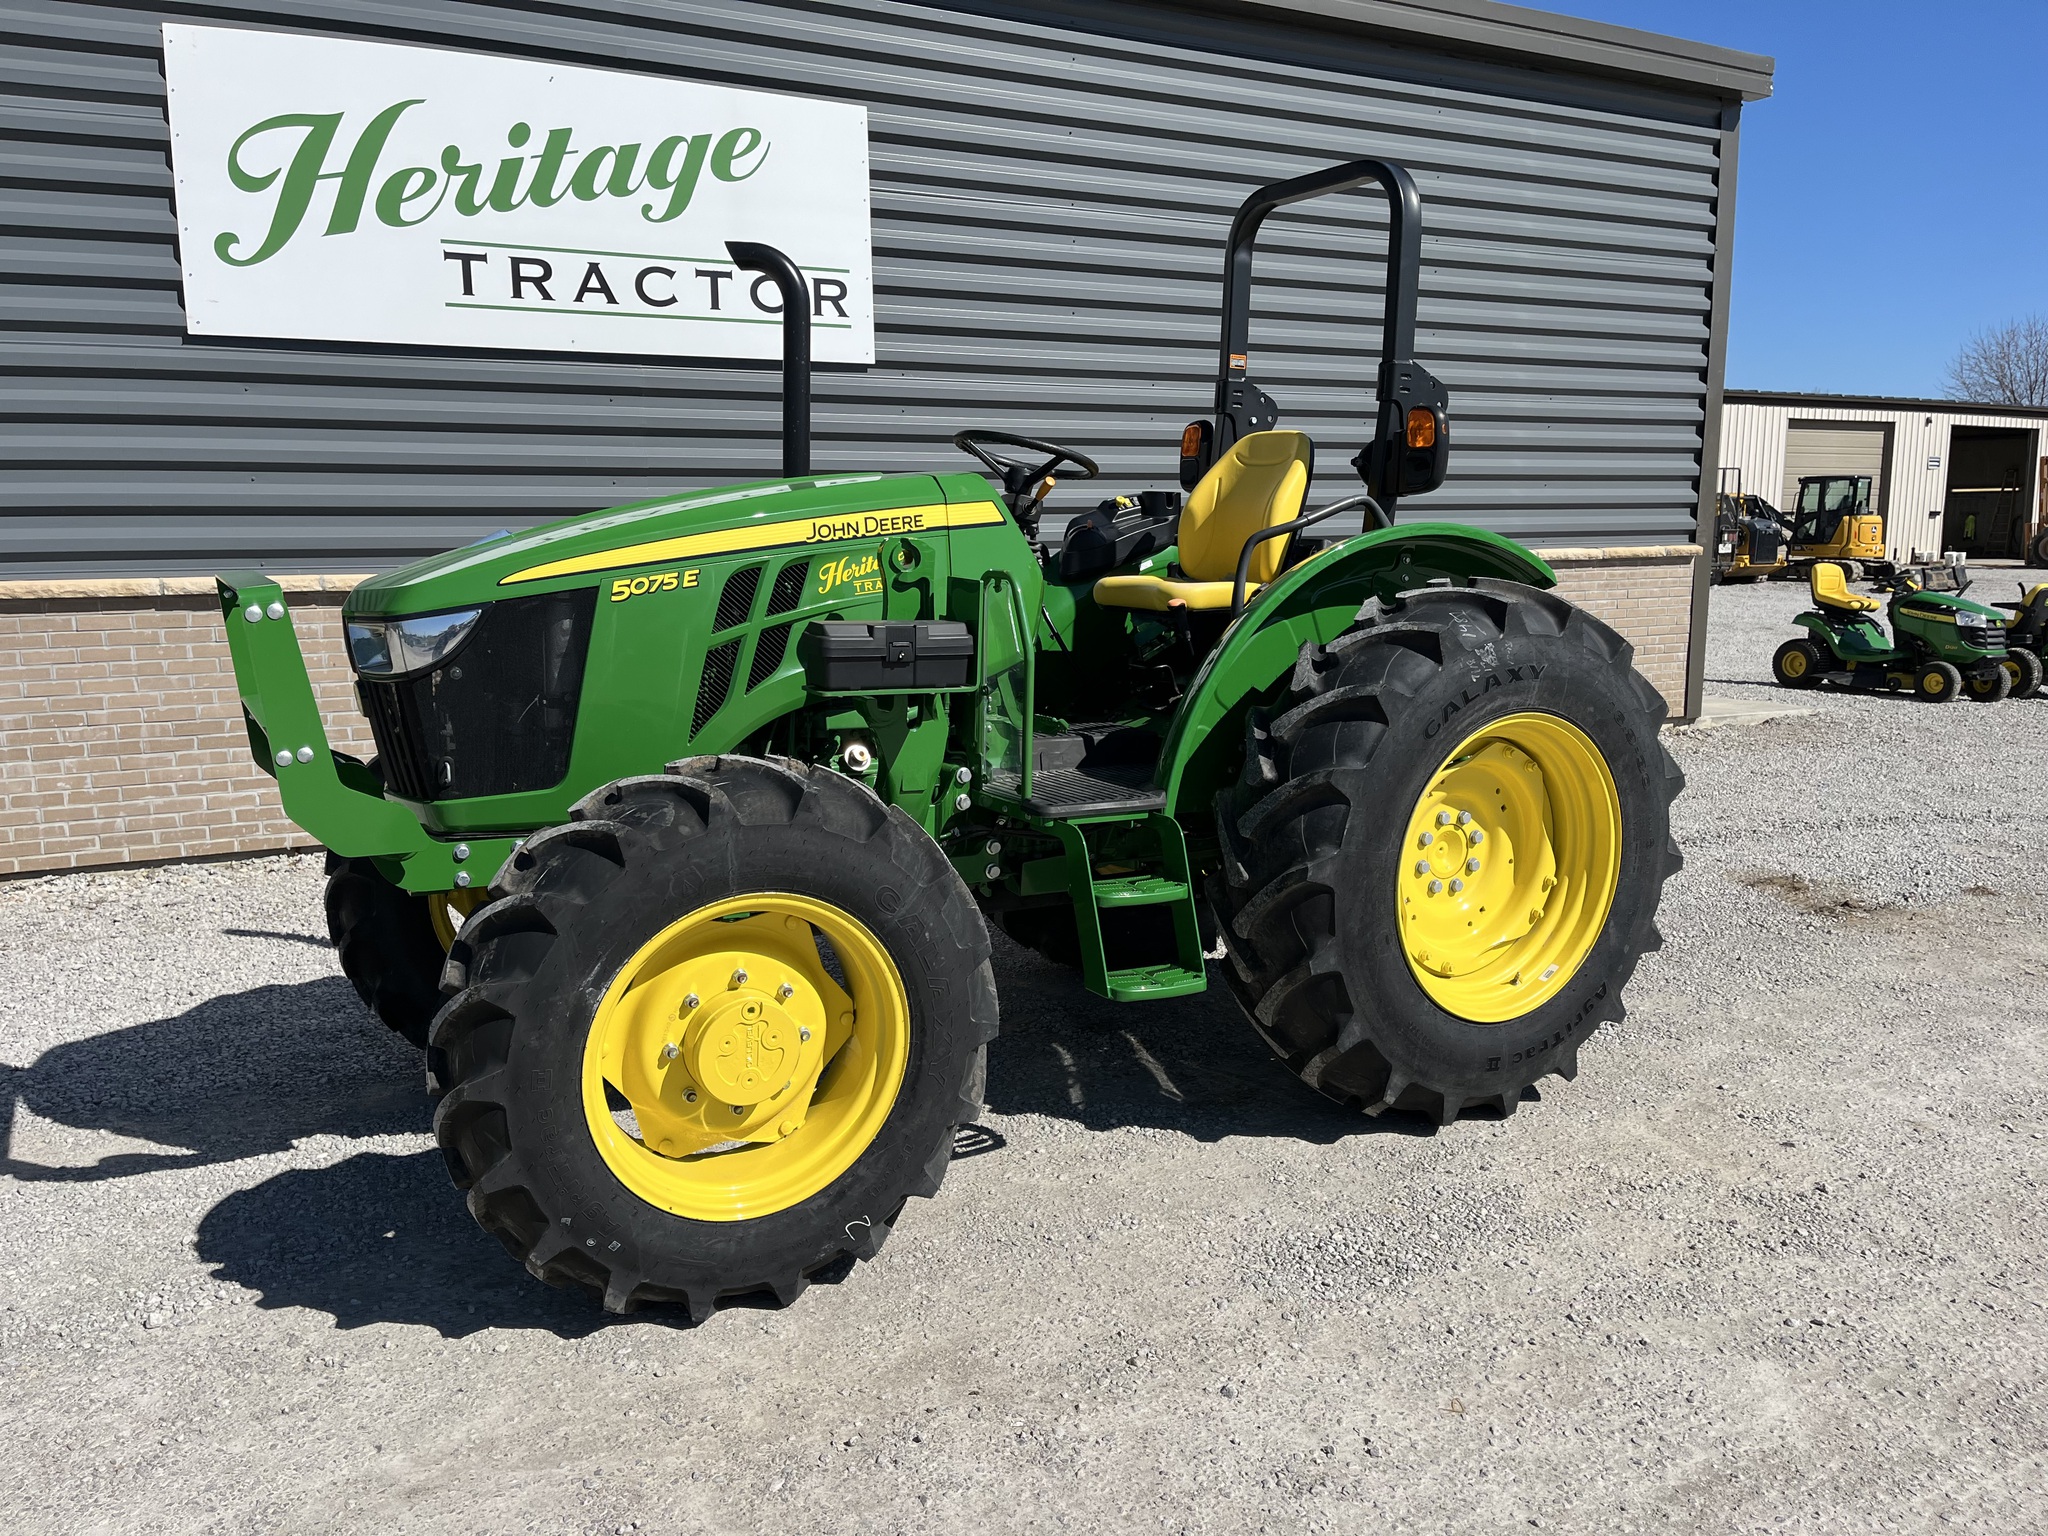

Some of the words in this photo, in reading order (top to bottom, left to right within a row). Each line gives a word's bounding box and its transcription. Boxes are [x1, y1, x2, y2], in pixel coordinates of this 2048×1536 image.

[214, 99, 771, 267] Heritage
[443, 249, 850, 318] TRACTOR
[806, 520, 859, 540] JOHN
[865, 514, 925, 533] DEERE
[1422, 663, 1548, 742] GALAXY
